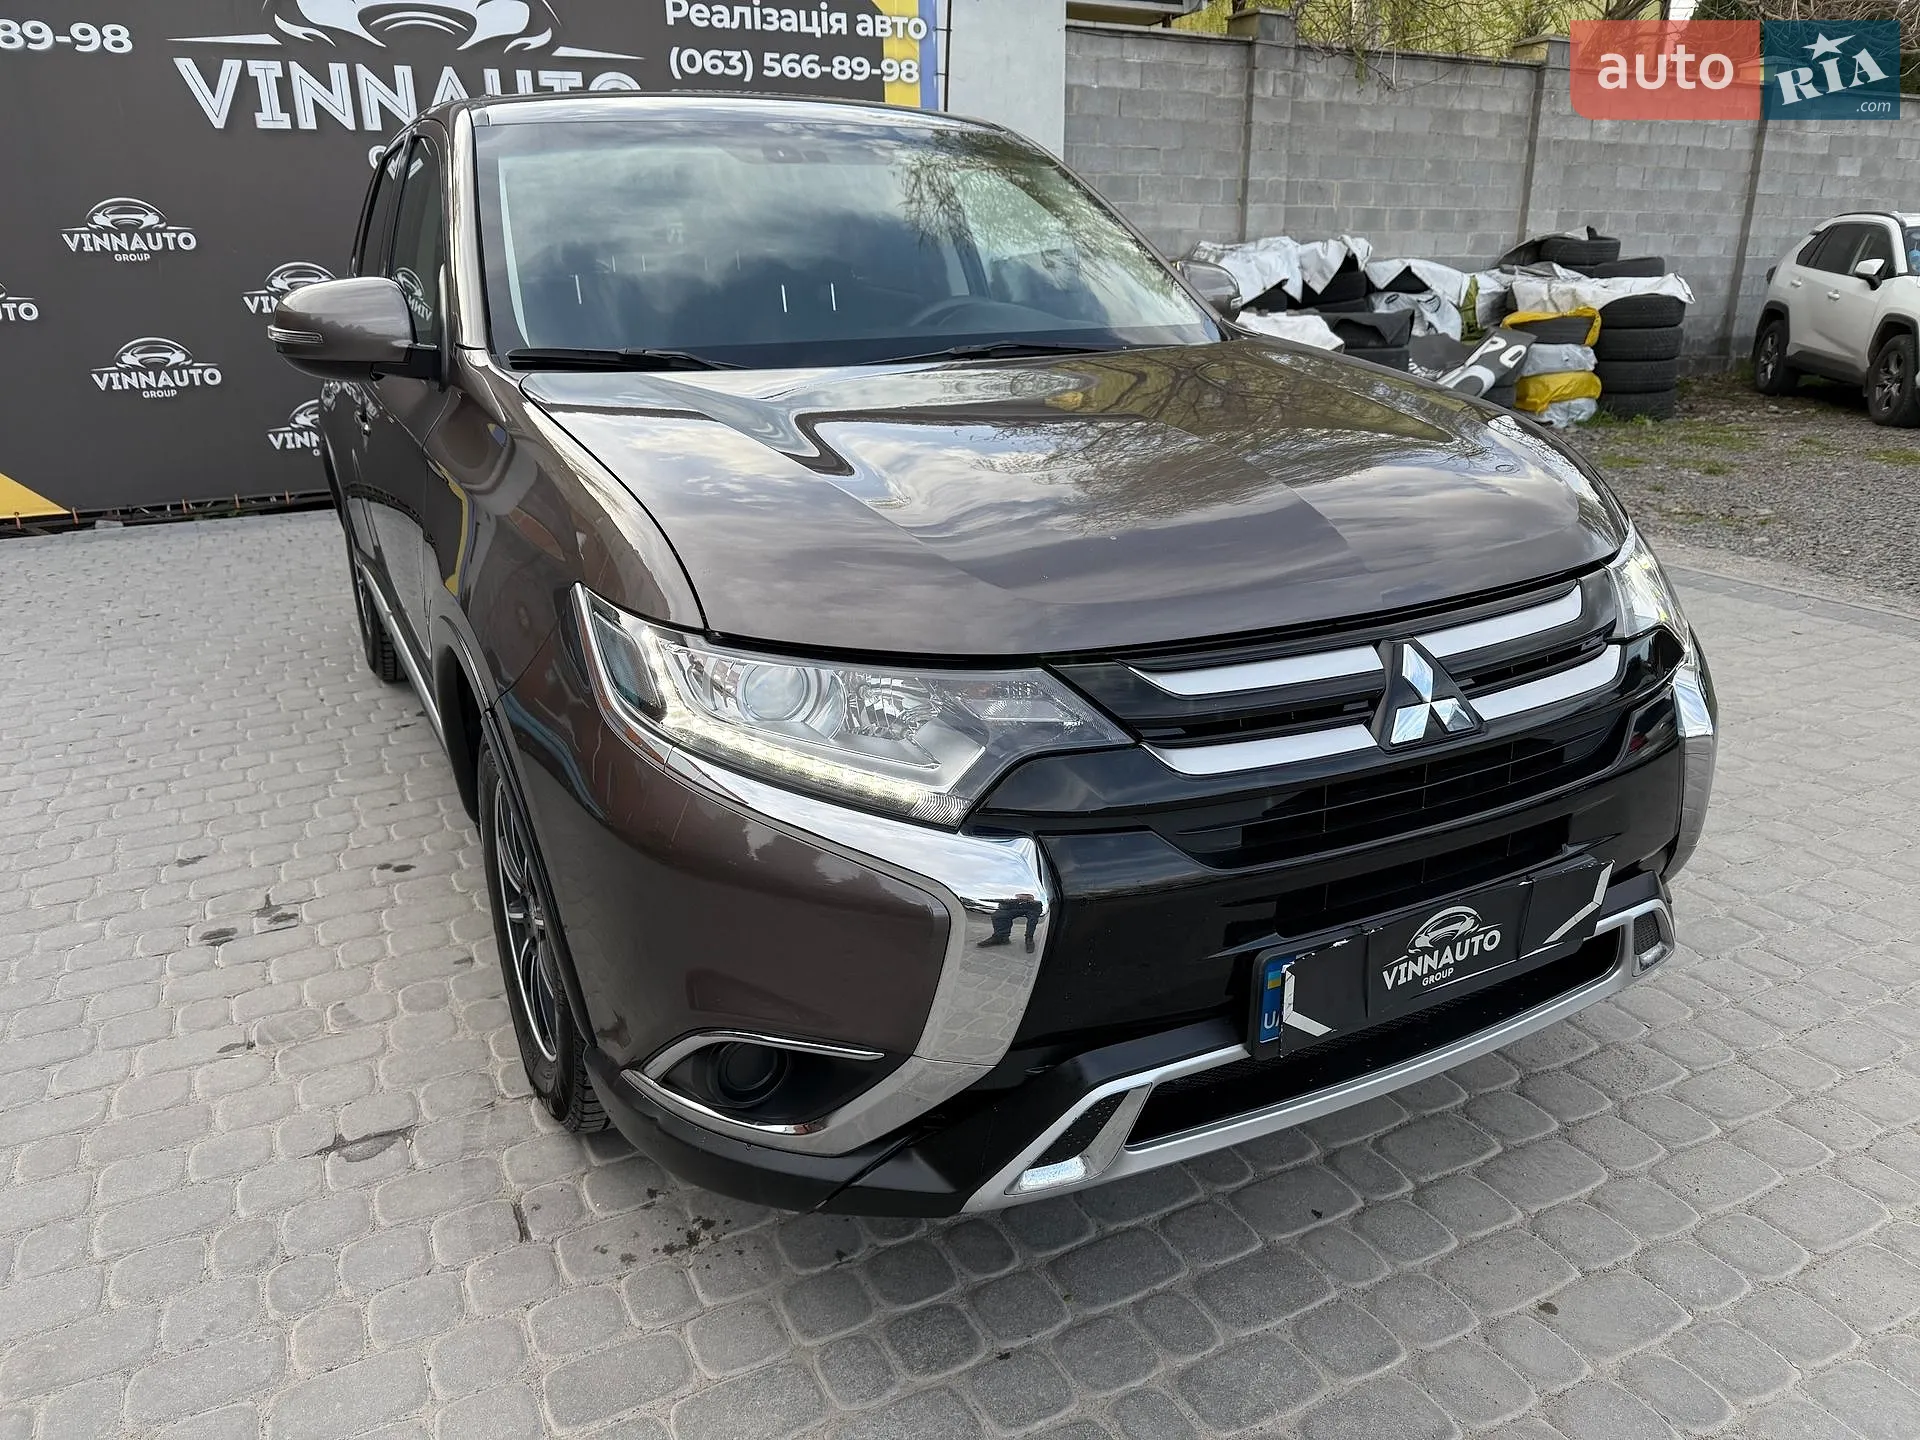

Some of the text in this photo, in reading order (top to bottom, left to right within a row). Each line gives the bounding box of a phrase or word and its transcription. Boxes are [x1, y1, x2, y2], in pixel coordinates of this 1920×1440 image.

[665, 0, 927, 40] Реалізація авто
[669, 46, 919, 84] (063) 566-89-98
[62, 231, 197, 252] VINNAUTO
[114, 252, 151, 262] GROUP
[0, 302, 39, 321] TO
[91, 368, 222, 390] VINNAUTO
[142, 389, 178, 399] GROUP
[1382, 931, 1501, 990] VINNAUTO
[1421, 967, 1454, 987] GROUP
